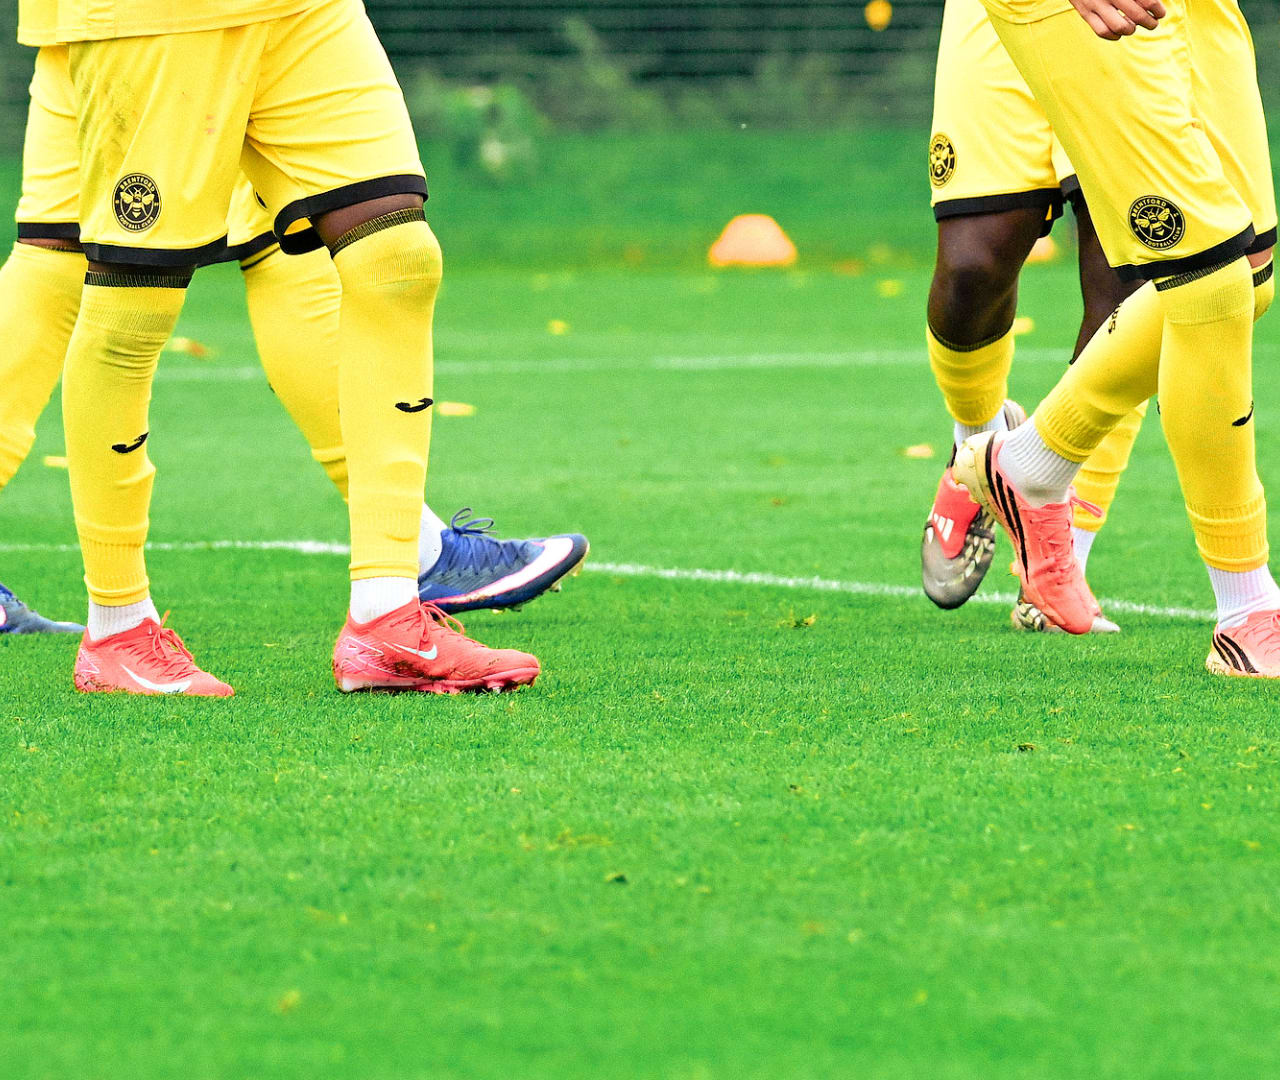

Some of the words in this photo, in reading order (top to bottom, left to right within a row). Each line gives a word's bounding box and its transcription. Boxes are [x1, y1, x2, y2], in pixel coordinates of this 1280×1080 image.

[119, 176, 156, 192] BRENTFORD
[1131, 198, 1167, 218] BRENTFORD
[1144, 238, 1174, 248] FOOTBALL
